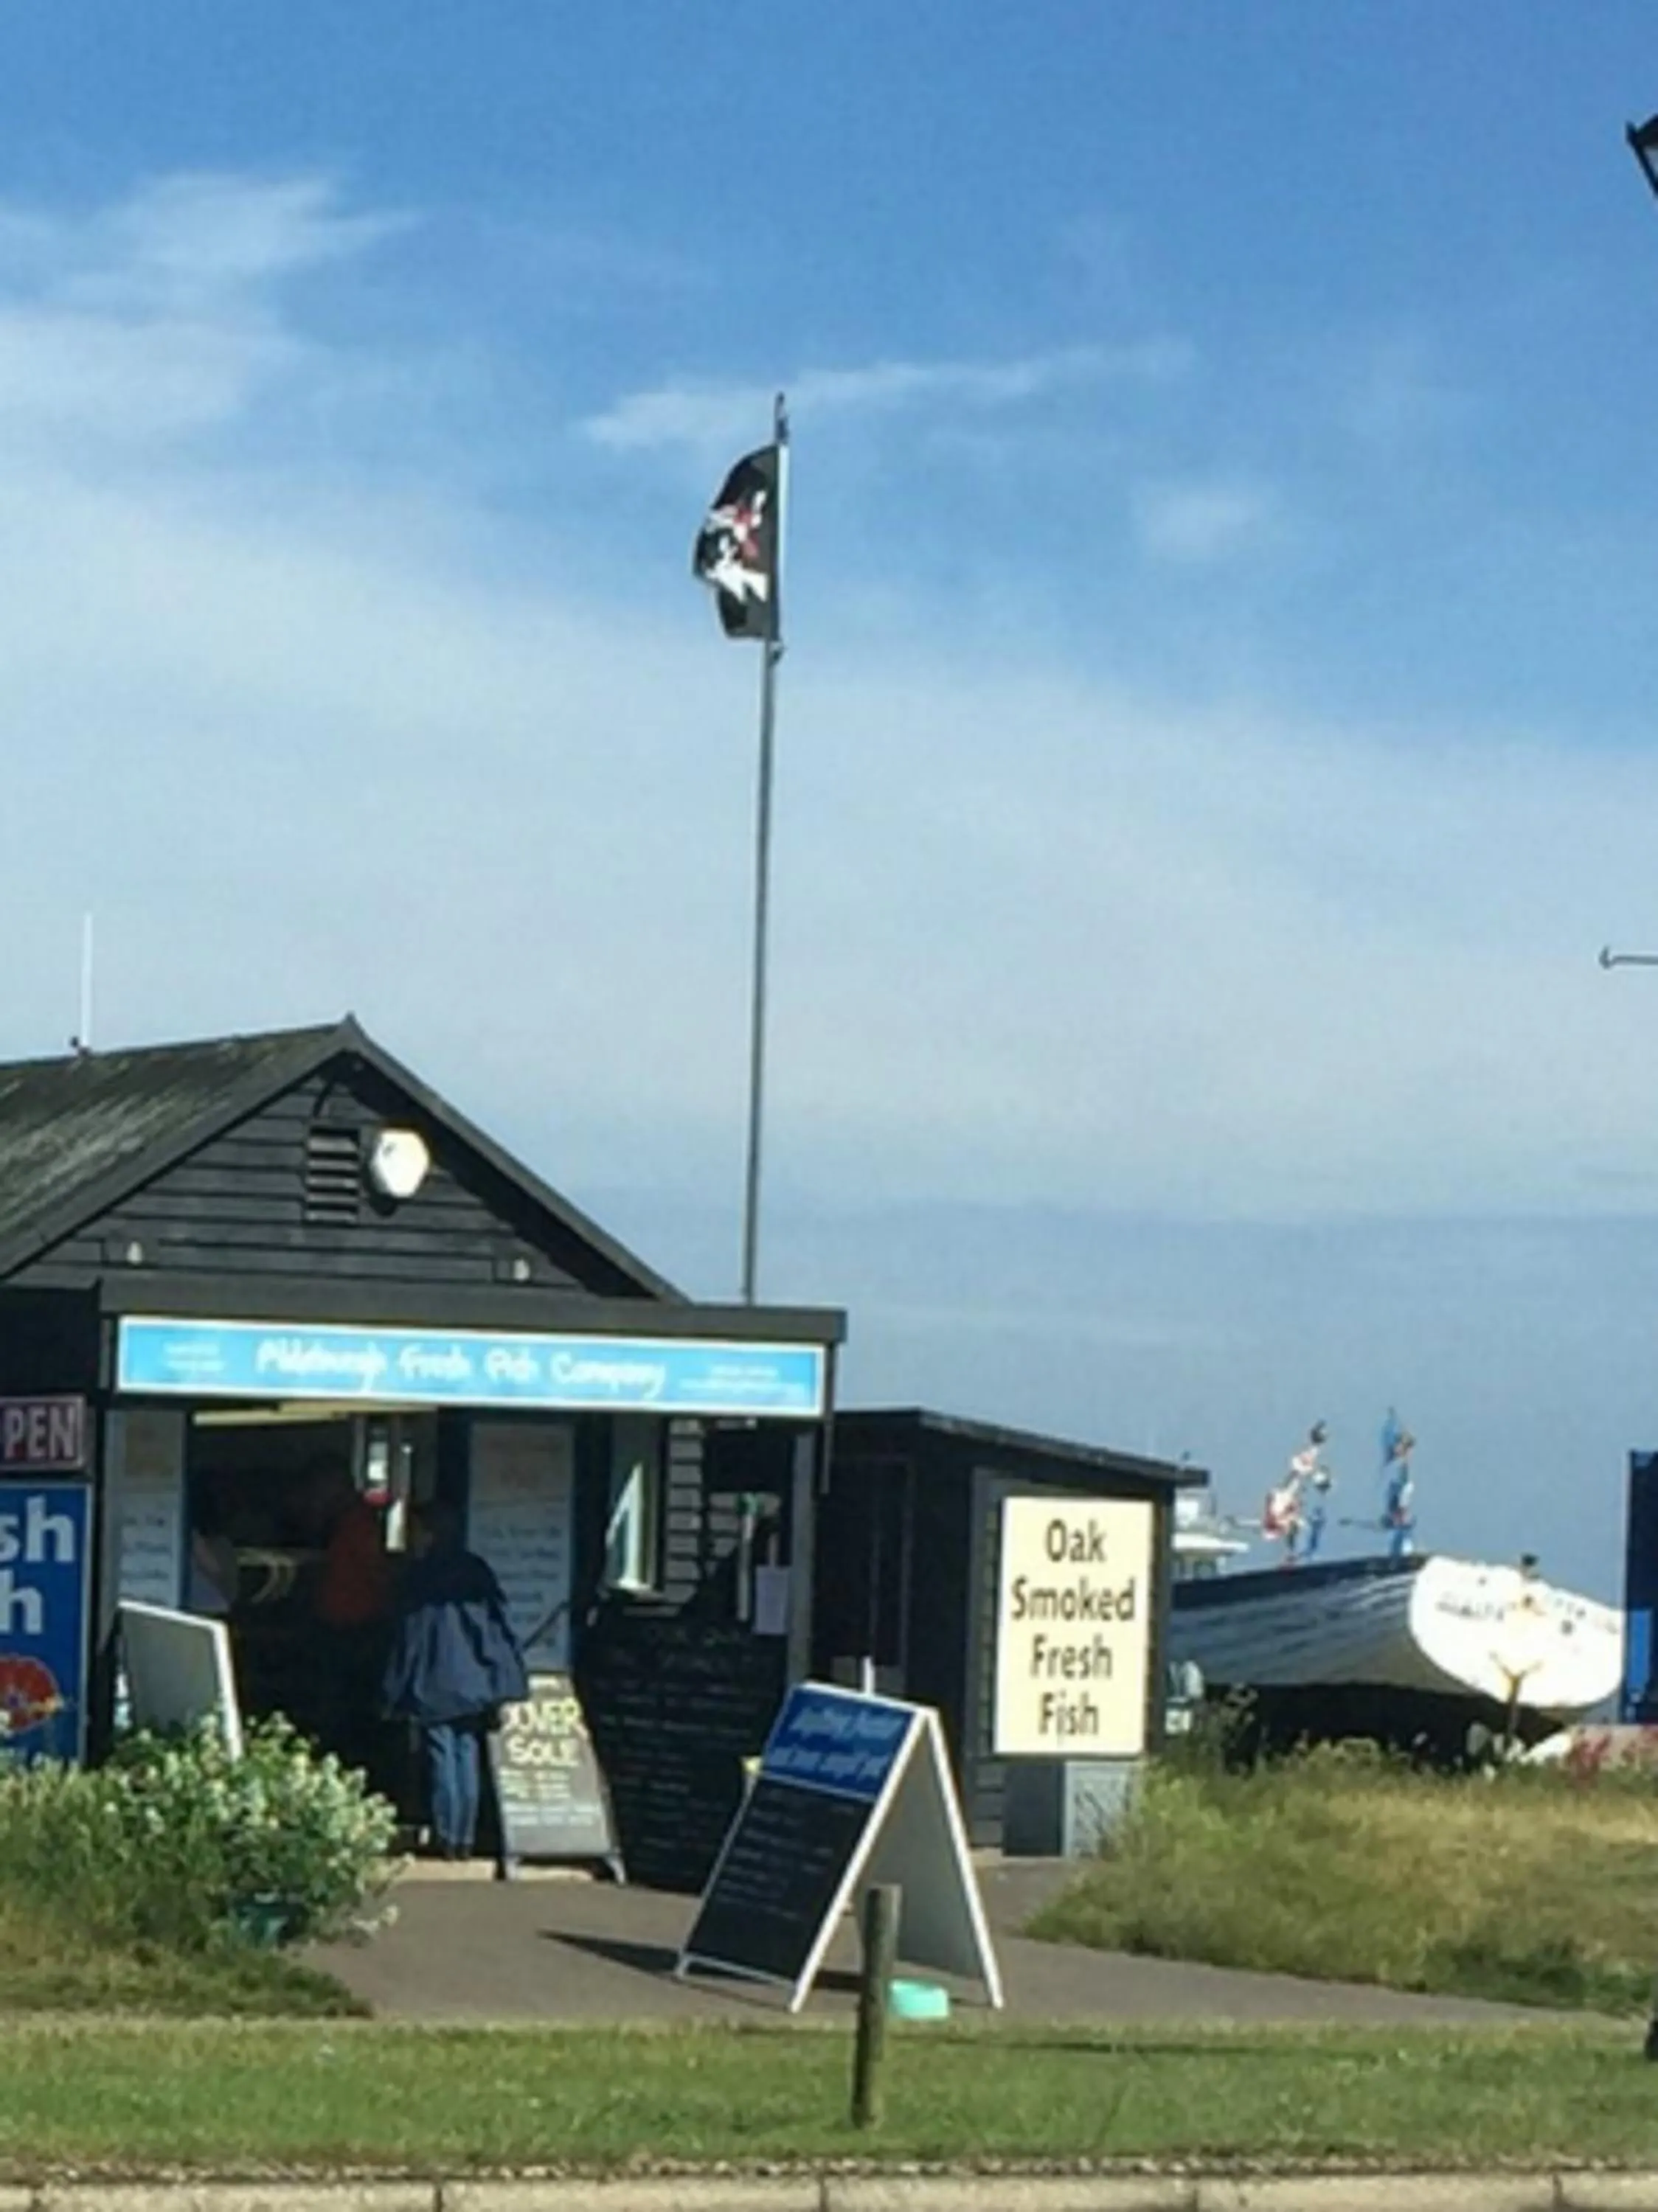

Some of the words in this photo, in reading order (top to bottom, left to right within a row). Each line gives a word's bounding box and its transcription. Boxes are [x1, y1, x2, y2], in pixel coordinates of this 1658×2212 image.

[1046, 1518, 1106, 1562] Oak
[1010, 1576, 1136, 1621] Smoked
[1030, 1634, 1112, 1680] Fresh
[1038, 1691, 1099, 1736] Fish
